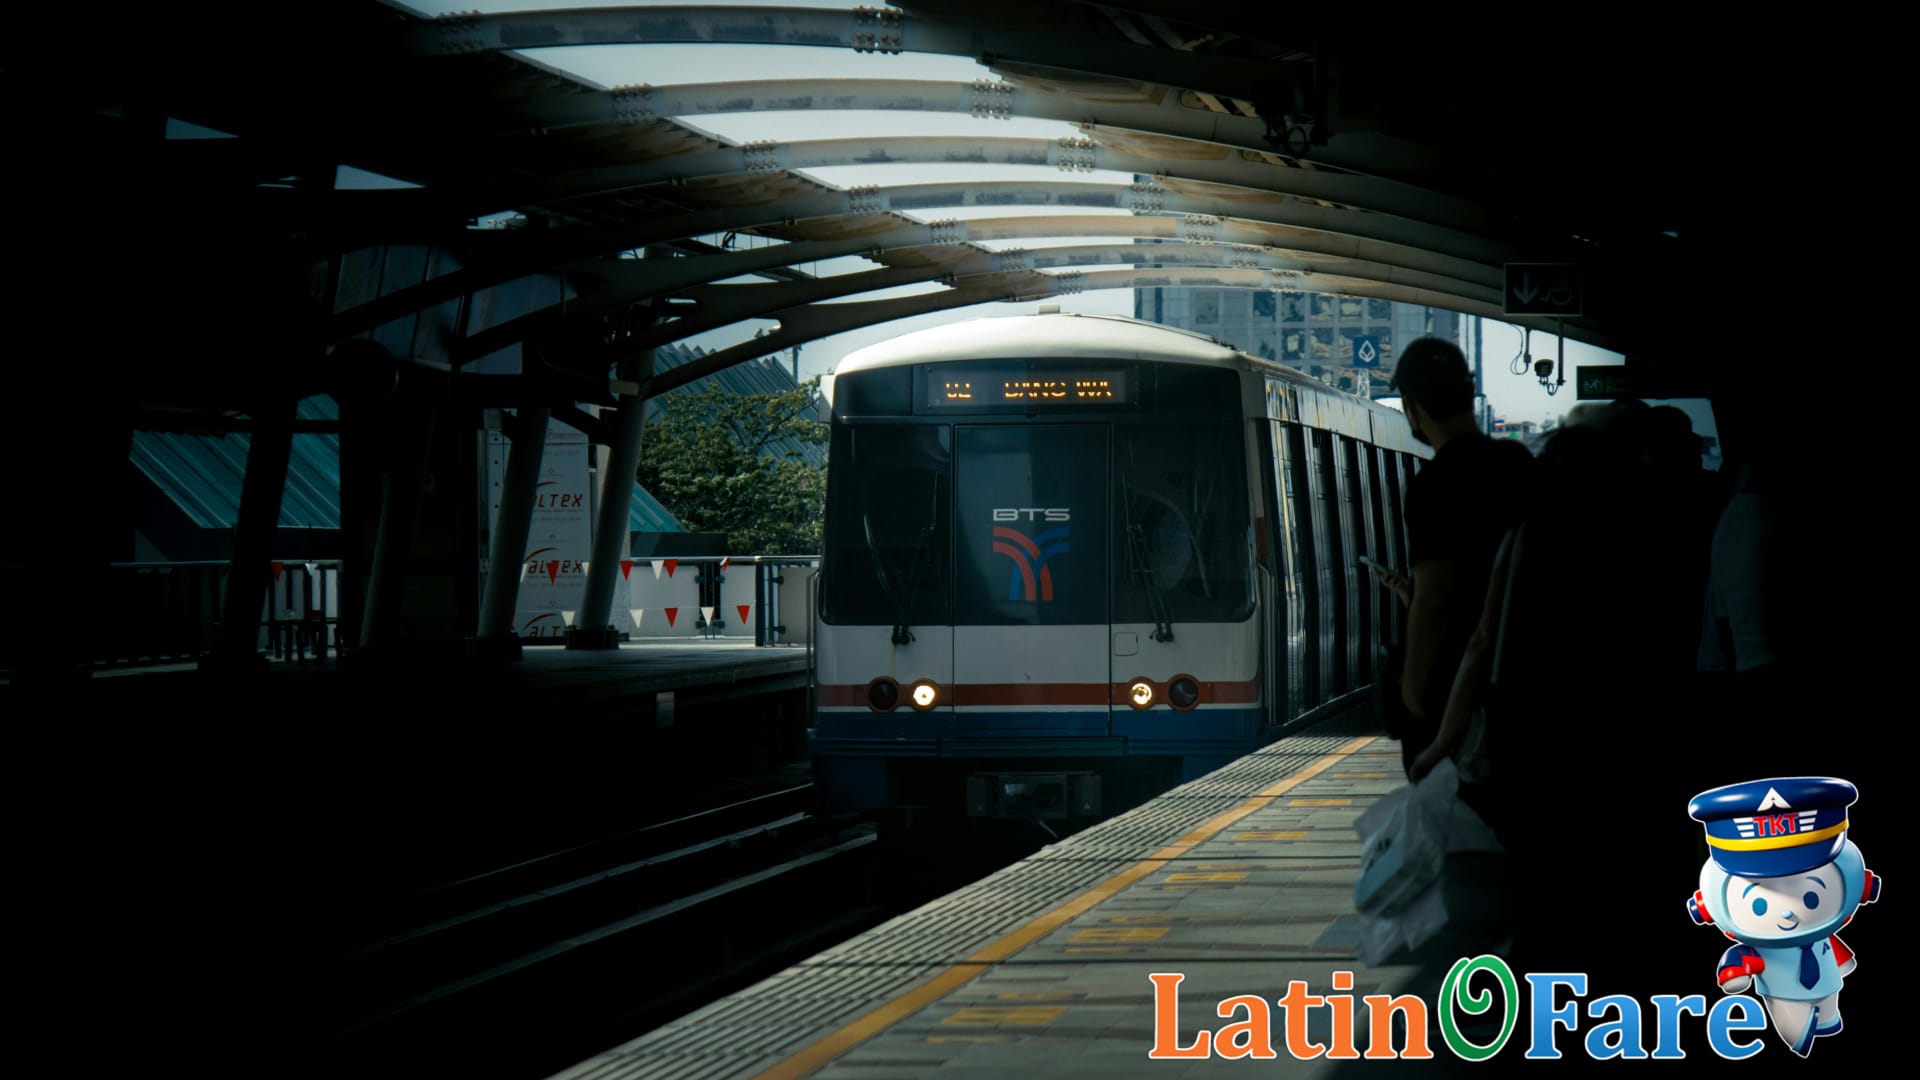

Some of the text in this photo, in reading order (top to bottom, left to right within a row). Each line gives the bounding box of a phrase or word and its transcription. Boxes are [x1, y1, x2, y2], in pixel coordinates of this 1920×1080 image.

[533, 493, 583, 508] LTex
[993, 508, 1070, 521] BTS
[528, 559, 584, 574] aLex
